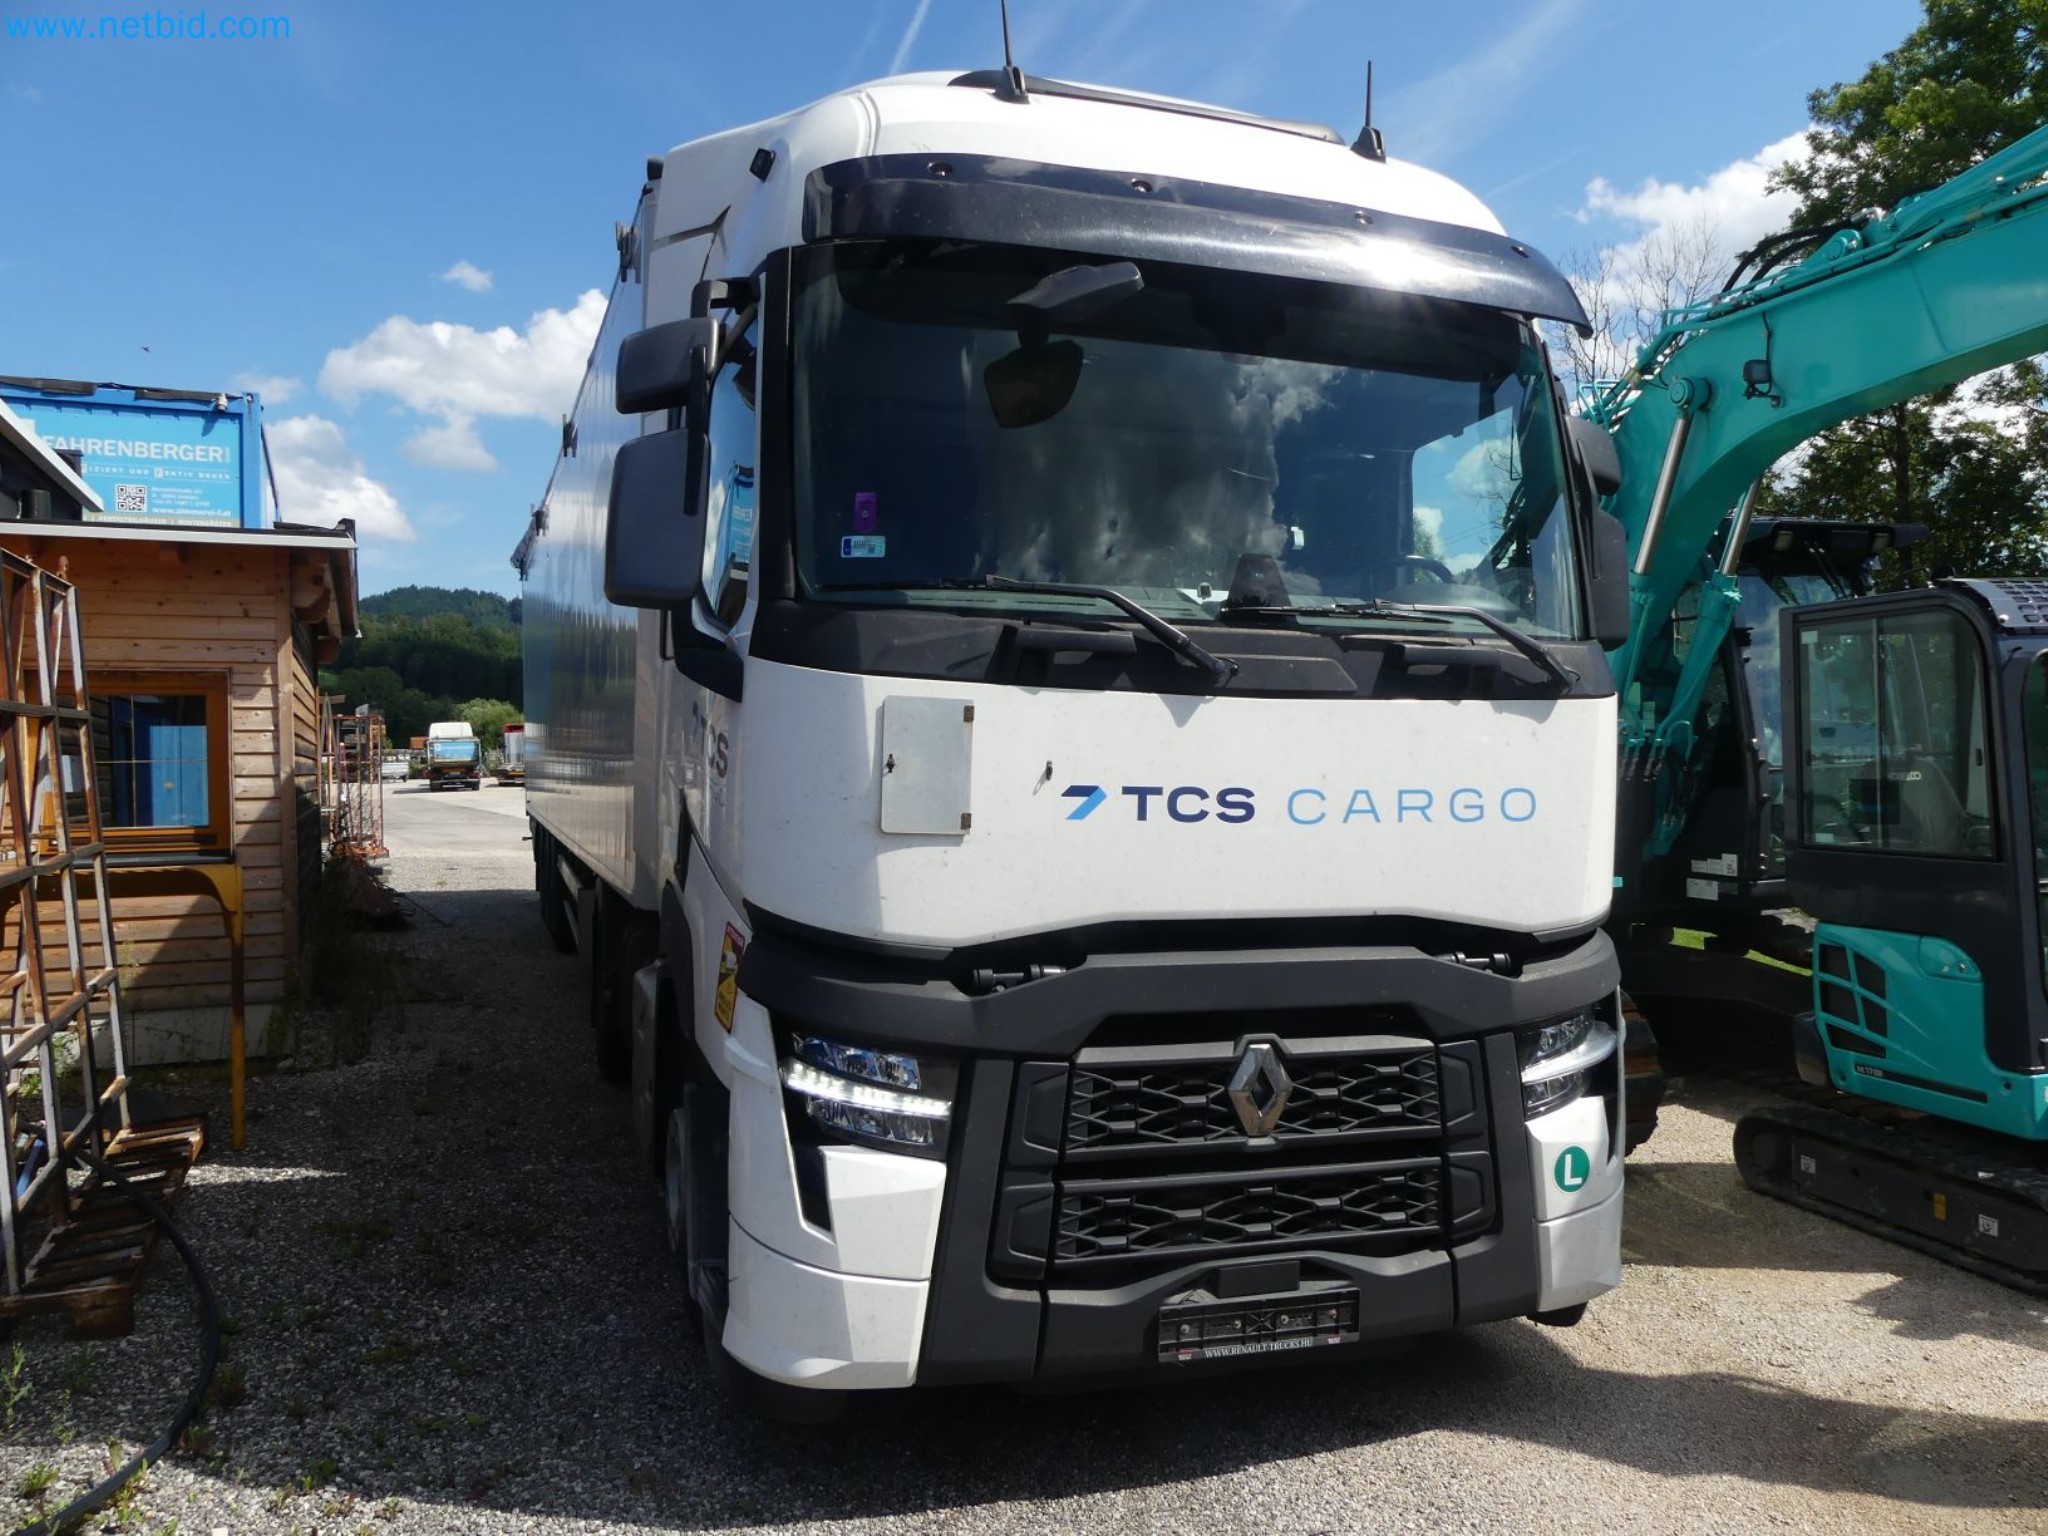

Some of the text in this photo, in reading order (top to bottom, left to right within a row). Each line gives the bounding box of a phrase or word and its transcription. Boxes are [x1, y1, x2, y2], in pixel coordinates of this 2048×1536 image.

[1121, 785, 1537, 826] TCS CARGO
[1564, 1153, 1583, 1186] L
[1205, 1335, 1314, 1359] WWW.RENAULT-TRUCKS.HU
